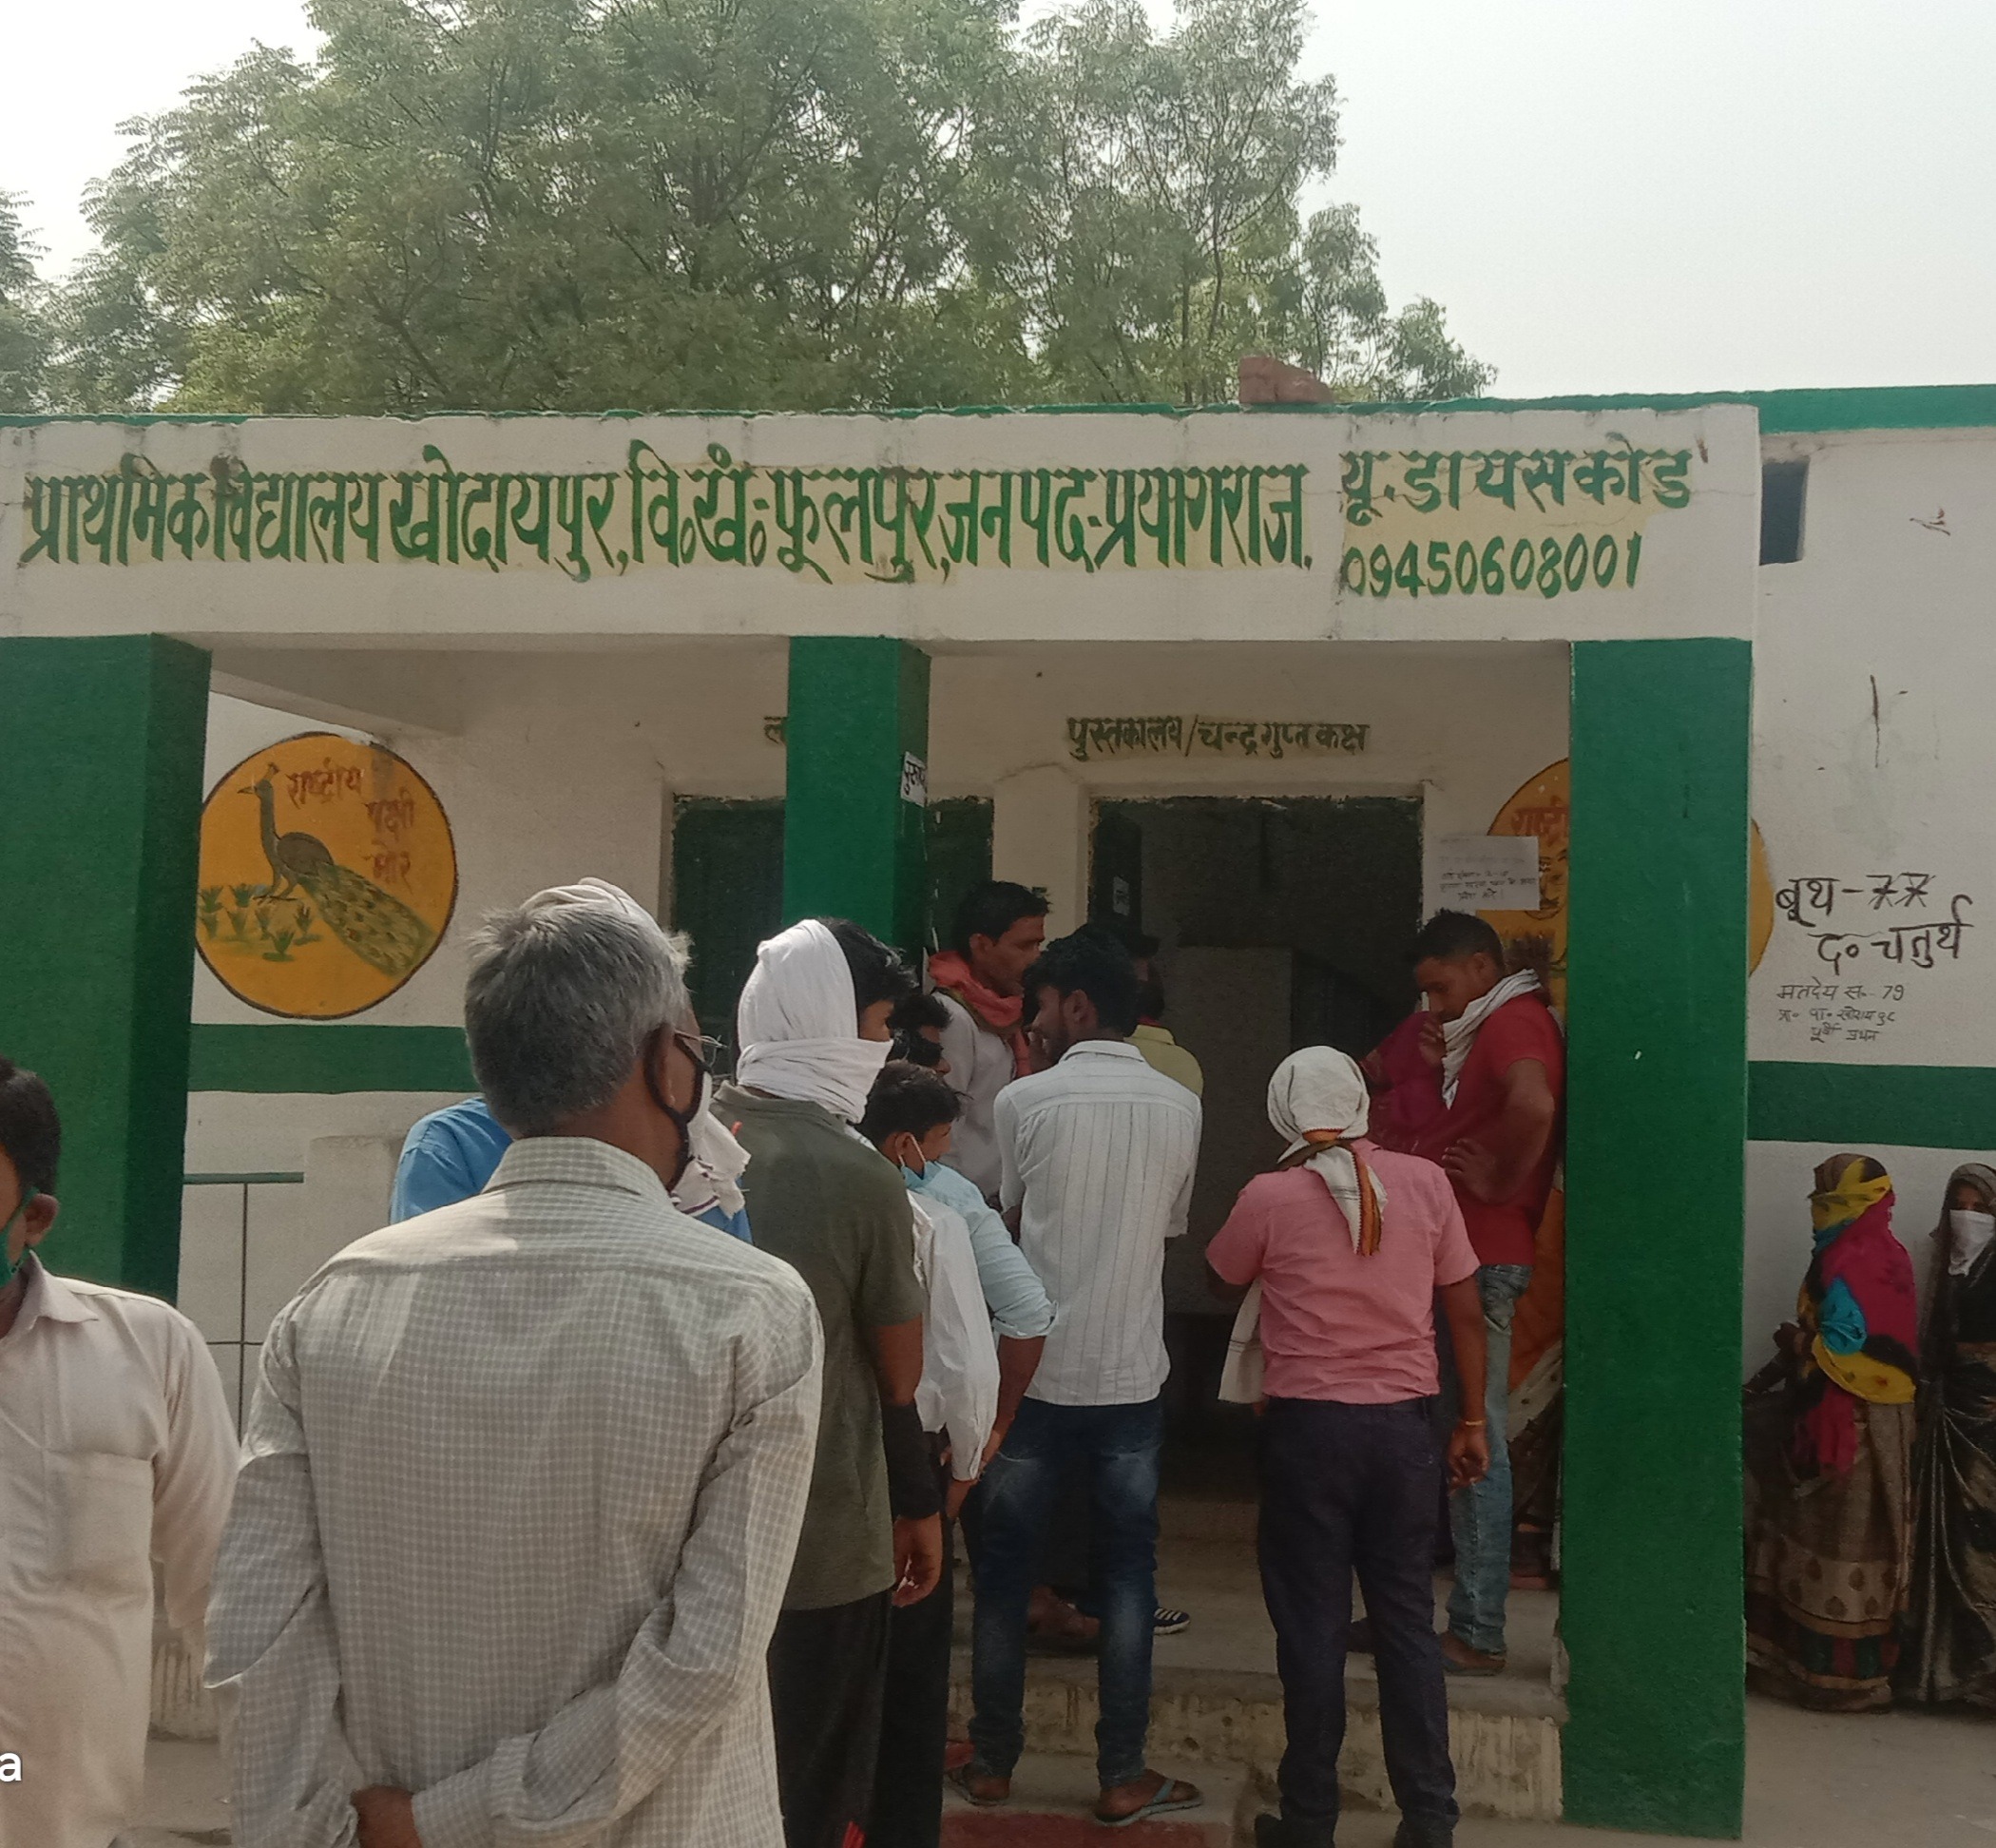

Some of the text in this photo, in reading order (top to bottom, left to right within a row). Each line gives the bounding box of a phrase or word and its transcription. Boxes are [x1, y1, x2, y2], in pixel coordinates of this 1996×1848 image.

[18, 452, 209, 568] प्राथमिक
[1340, 531, 1642, 599] 09450608001
[1871, 894, 1975, 969] चतुर्थ
[1882, 984, 1905, 1001] 79
